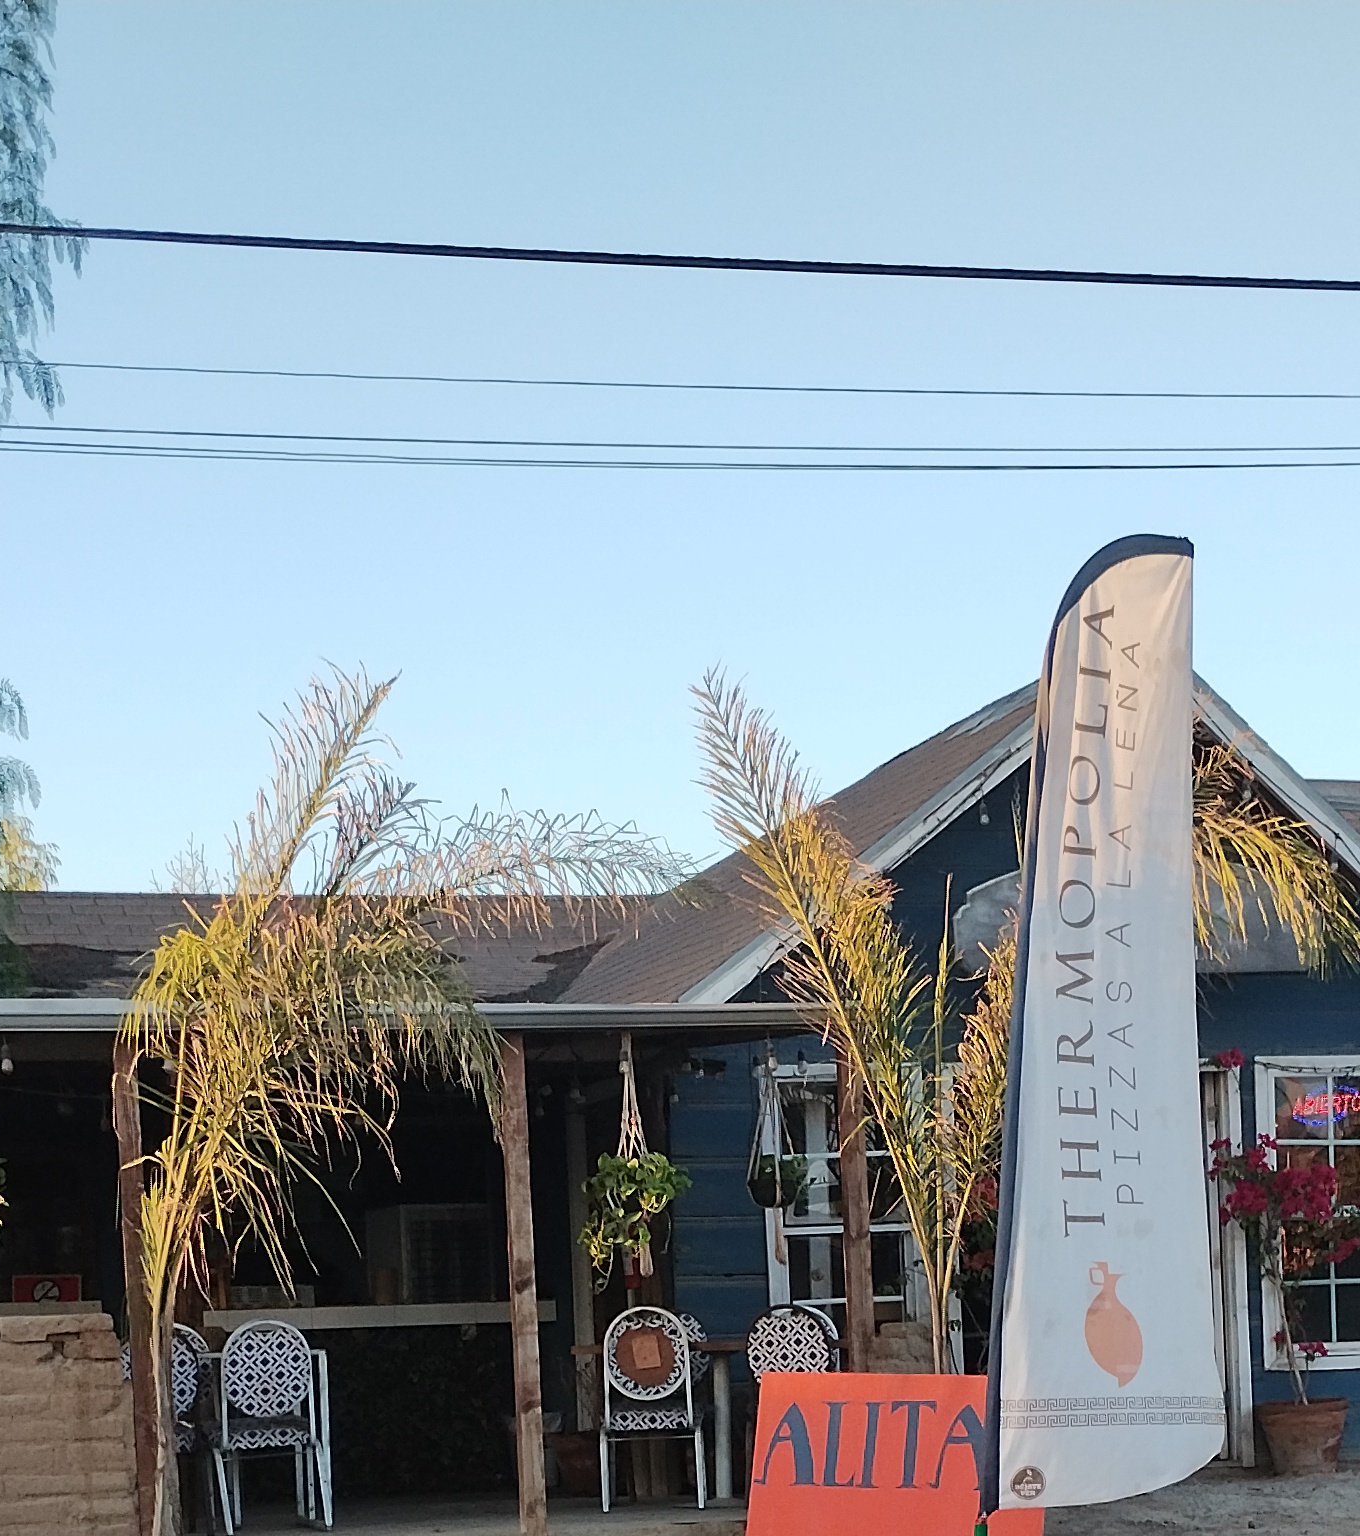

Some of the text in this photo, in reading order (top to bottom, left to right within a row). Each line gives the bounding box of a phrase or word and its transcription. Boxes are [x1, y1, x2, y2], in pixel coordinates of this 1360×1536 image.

[1054, 603, 1115, 1238] THERMOPOLIA
[1104, 641, 1144, 1205] PIZZAS A LA LEÑA
